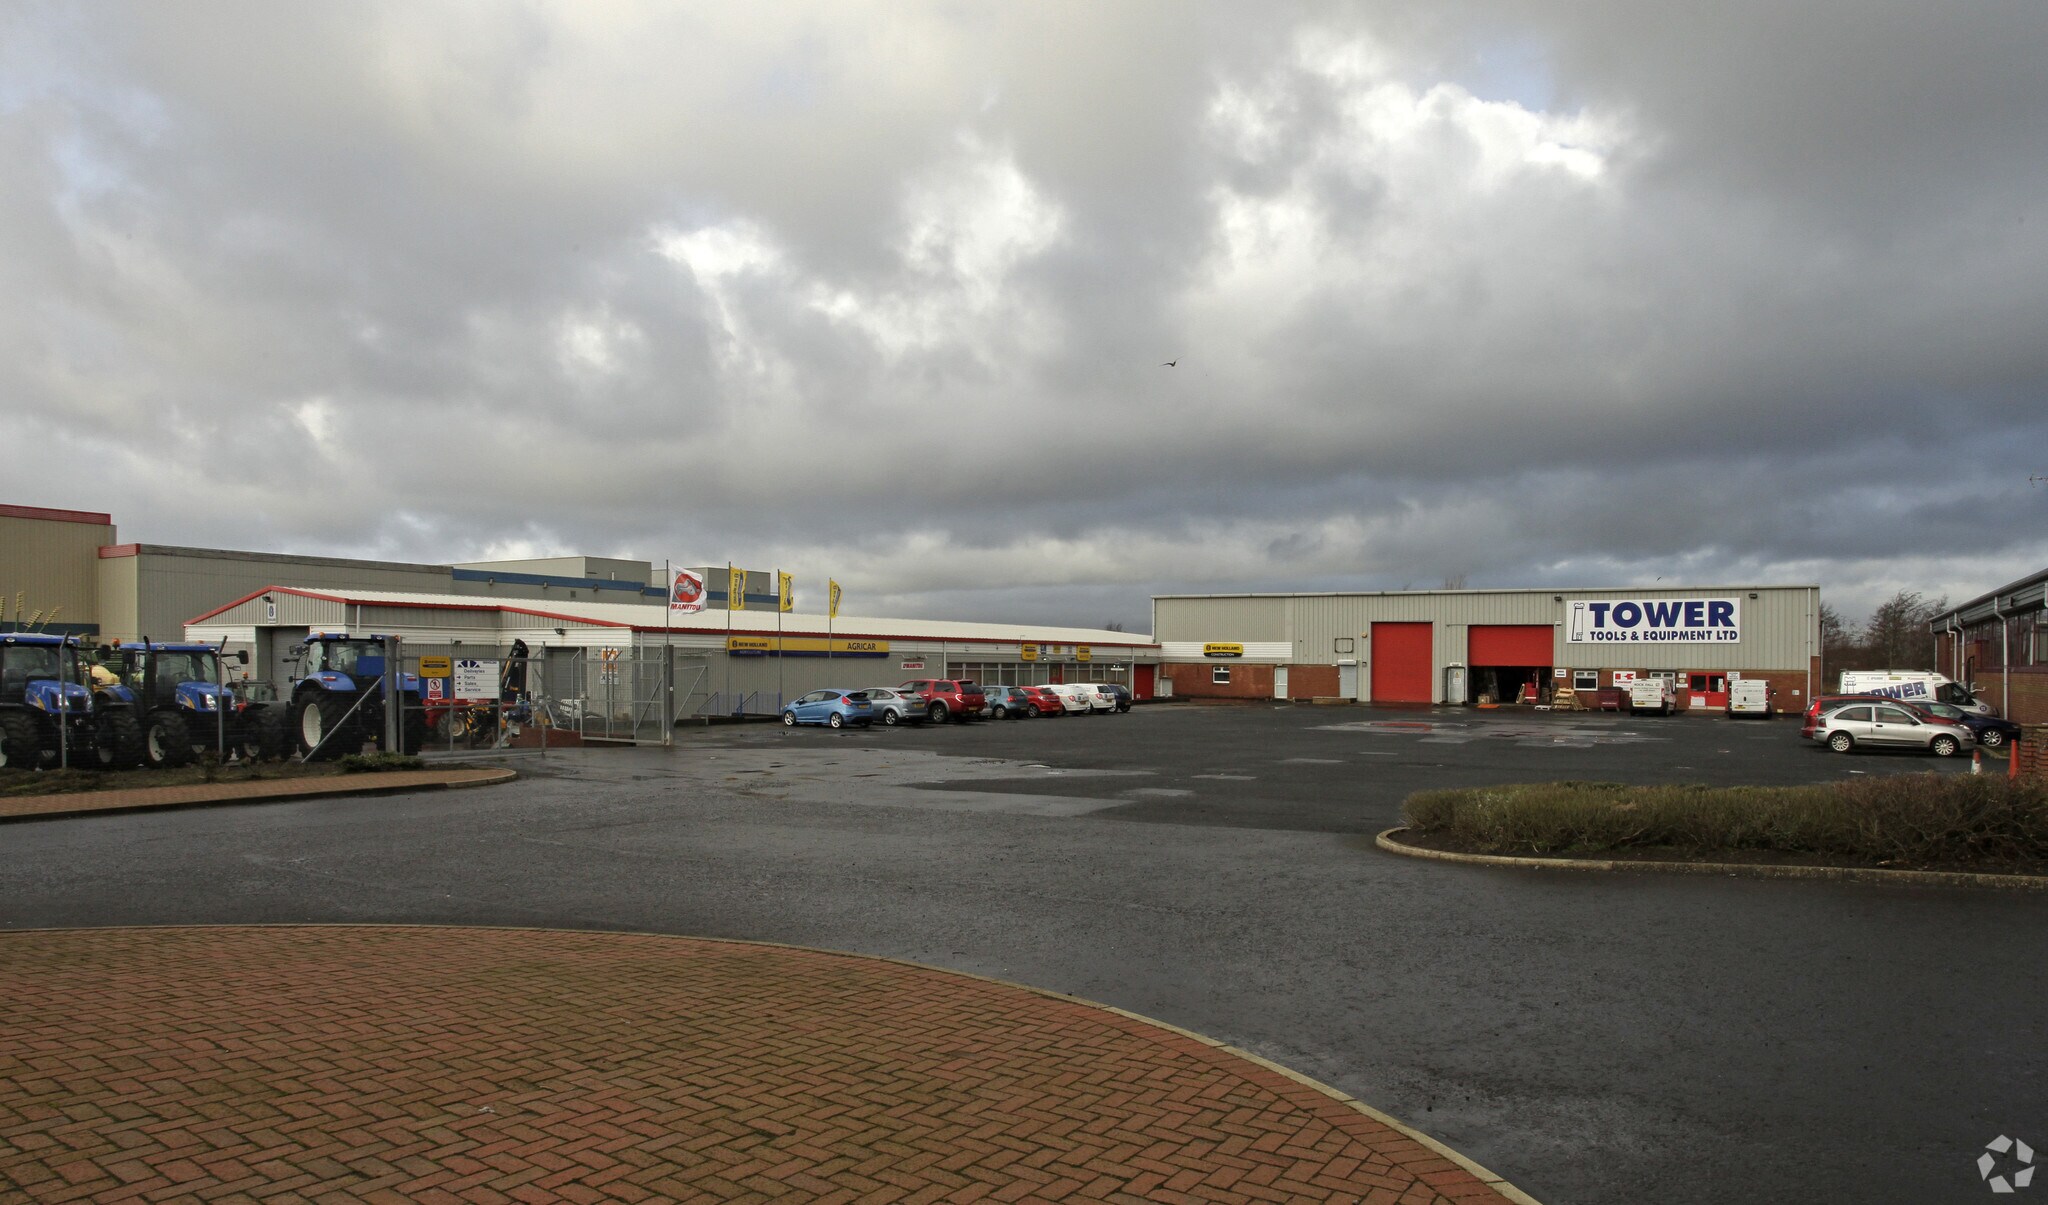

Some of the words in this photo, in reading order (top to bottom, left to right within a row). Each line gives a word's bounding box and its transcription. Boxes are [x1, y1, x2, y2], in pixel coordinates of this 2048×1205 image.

[670, 603, 701, 611] MANITOU
[1589, 601, 1736, 628] TOWER
[1590, 631, 1627, 641] TOOLS
[1630, 631, 1639, 641] &
[1643, 630, 1712, 641] EQUIPMENT
[1716, 630, 1738, 641] LTD
[847, 642, 876, 651] AGRICAR
[1858, 681, 1926, 698] OWER
